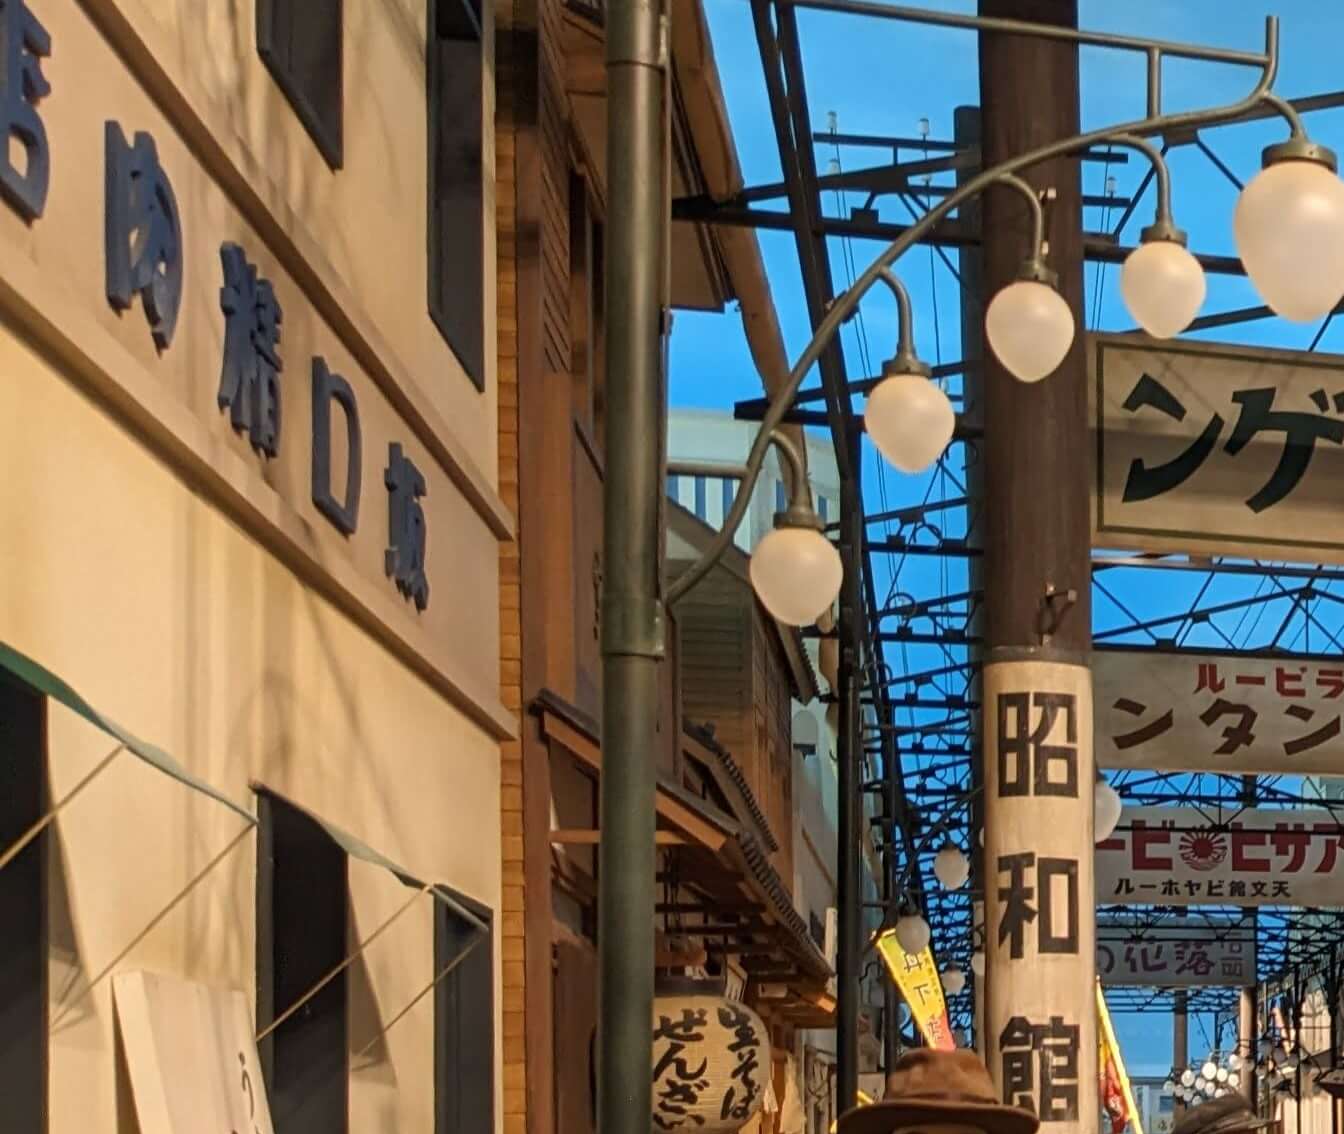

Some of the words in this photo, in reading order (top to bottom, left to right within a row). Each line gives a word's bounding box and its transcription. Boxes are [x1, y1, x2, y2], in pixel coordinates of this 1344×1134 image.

[996, 692, 1080, 1122] 昭和館
[653, 1008, 710, 1130] ぜんざい
